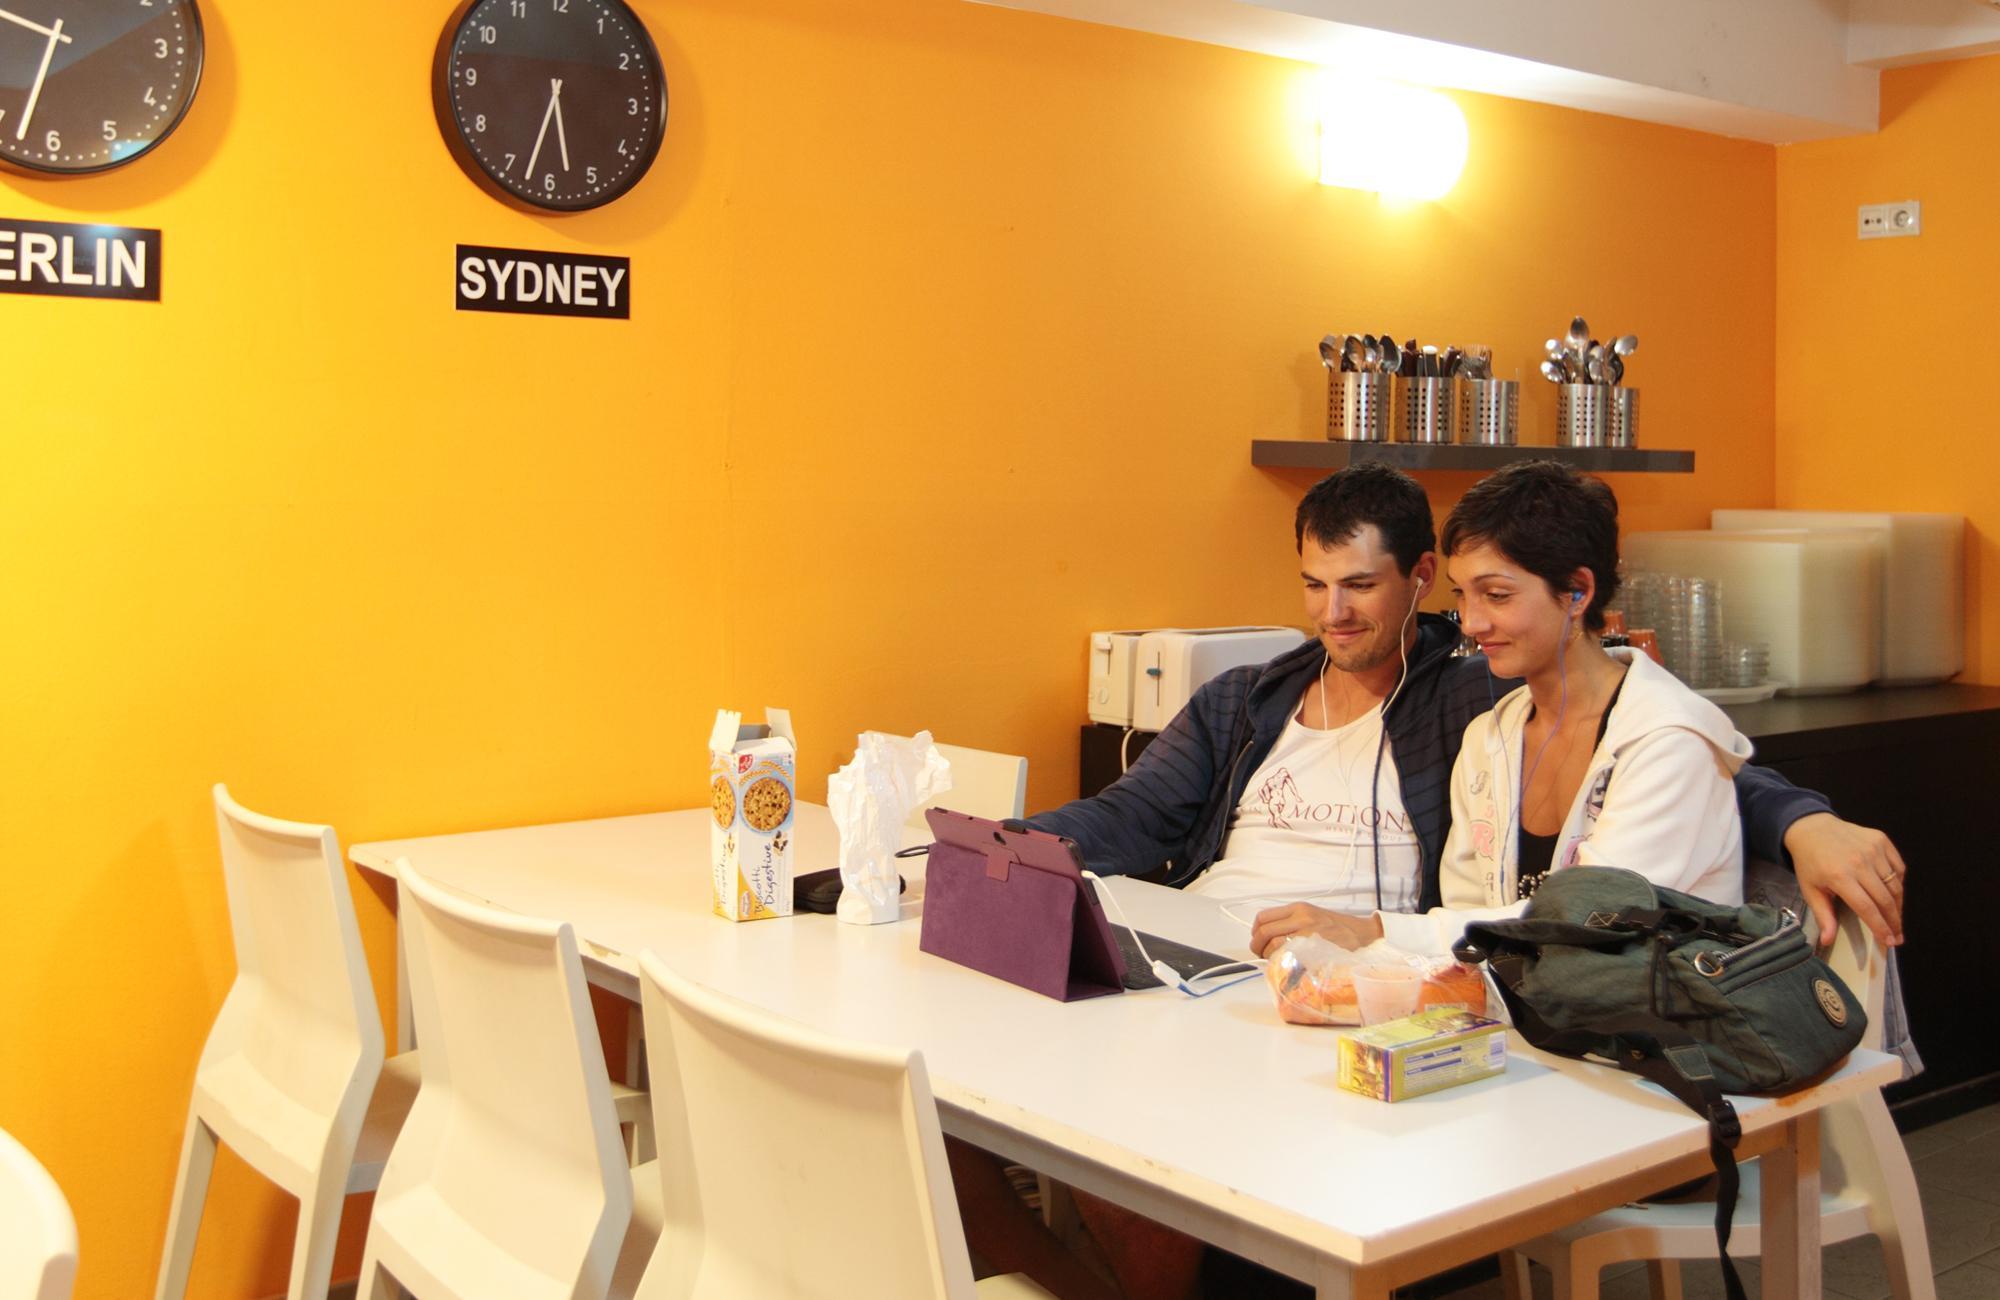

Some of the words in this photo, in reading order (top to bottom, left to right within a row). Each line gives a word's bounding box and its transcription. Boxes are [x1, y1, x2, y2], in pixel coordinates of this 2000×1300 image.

[510, 1, 526, 18] 11
[479, 25, 497, 44] 10
[596, 18, 605, 34] 1
[154, 38, 169, 59] 3
[618, 53, 630, 71] 2
[465, 67, 478, 86] 9
[143, 86, 157, 107] 4
[627, 98, 639, 116] 3
[102, 120, 118, 141] 5
[475, 114, 487, 132] 8
[46, 130, 62, 152] 6
[617, 139, 628, 157] 4
[504, 153, 516, 172] 7
[544, 173, 556, 192] 6
[586, 166, 598, 184] 5
[459, 256, 626, 307] SYDNEY
[762, 842, 775, 905] Digestive
